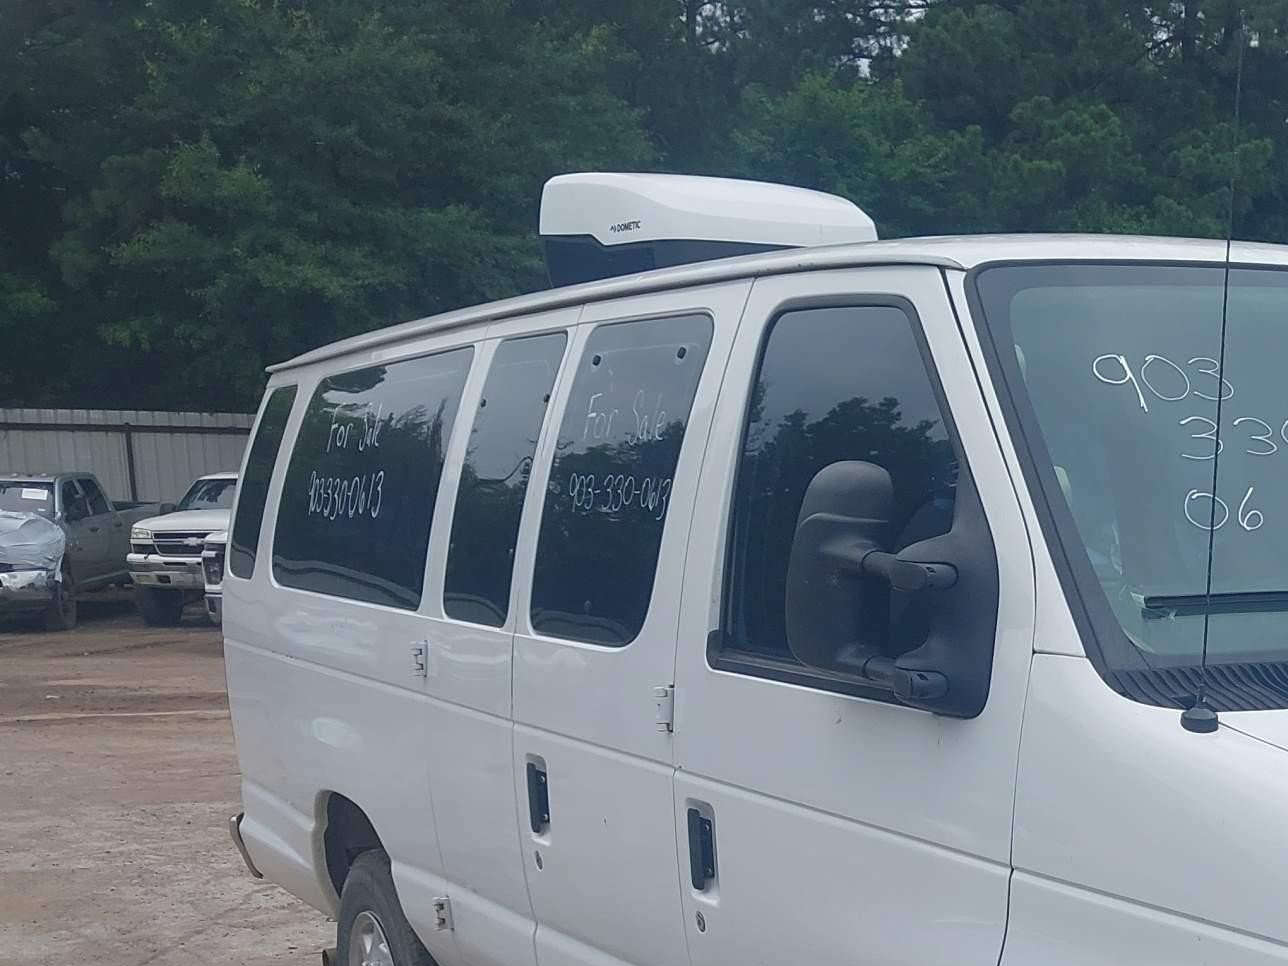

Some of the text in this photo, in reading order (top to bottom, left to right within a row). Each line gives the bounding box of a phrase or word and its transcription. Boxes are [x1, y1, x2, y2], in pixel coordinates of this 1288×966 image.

[616, 220, 641, 232] DOMETIC
[1092, 353, 1235, 413] 903
[326, 402, 353, 452] For
[583, 389, 665, 445] For Sale
[569, 472, 672, 520] 903-330-0613
